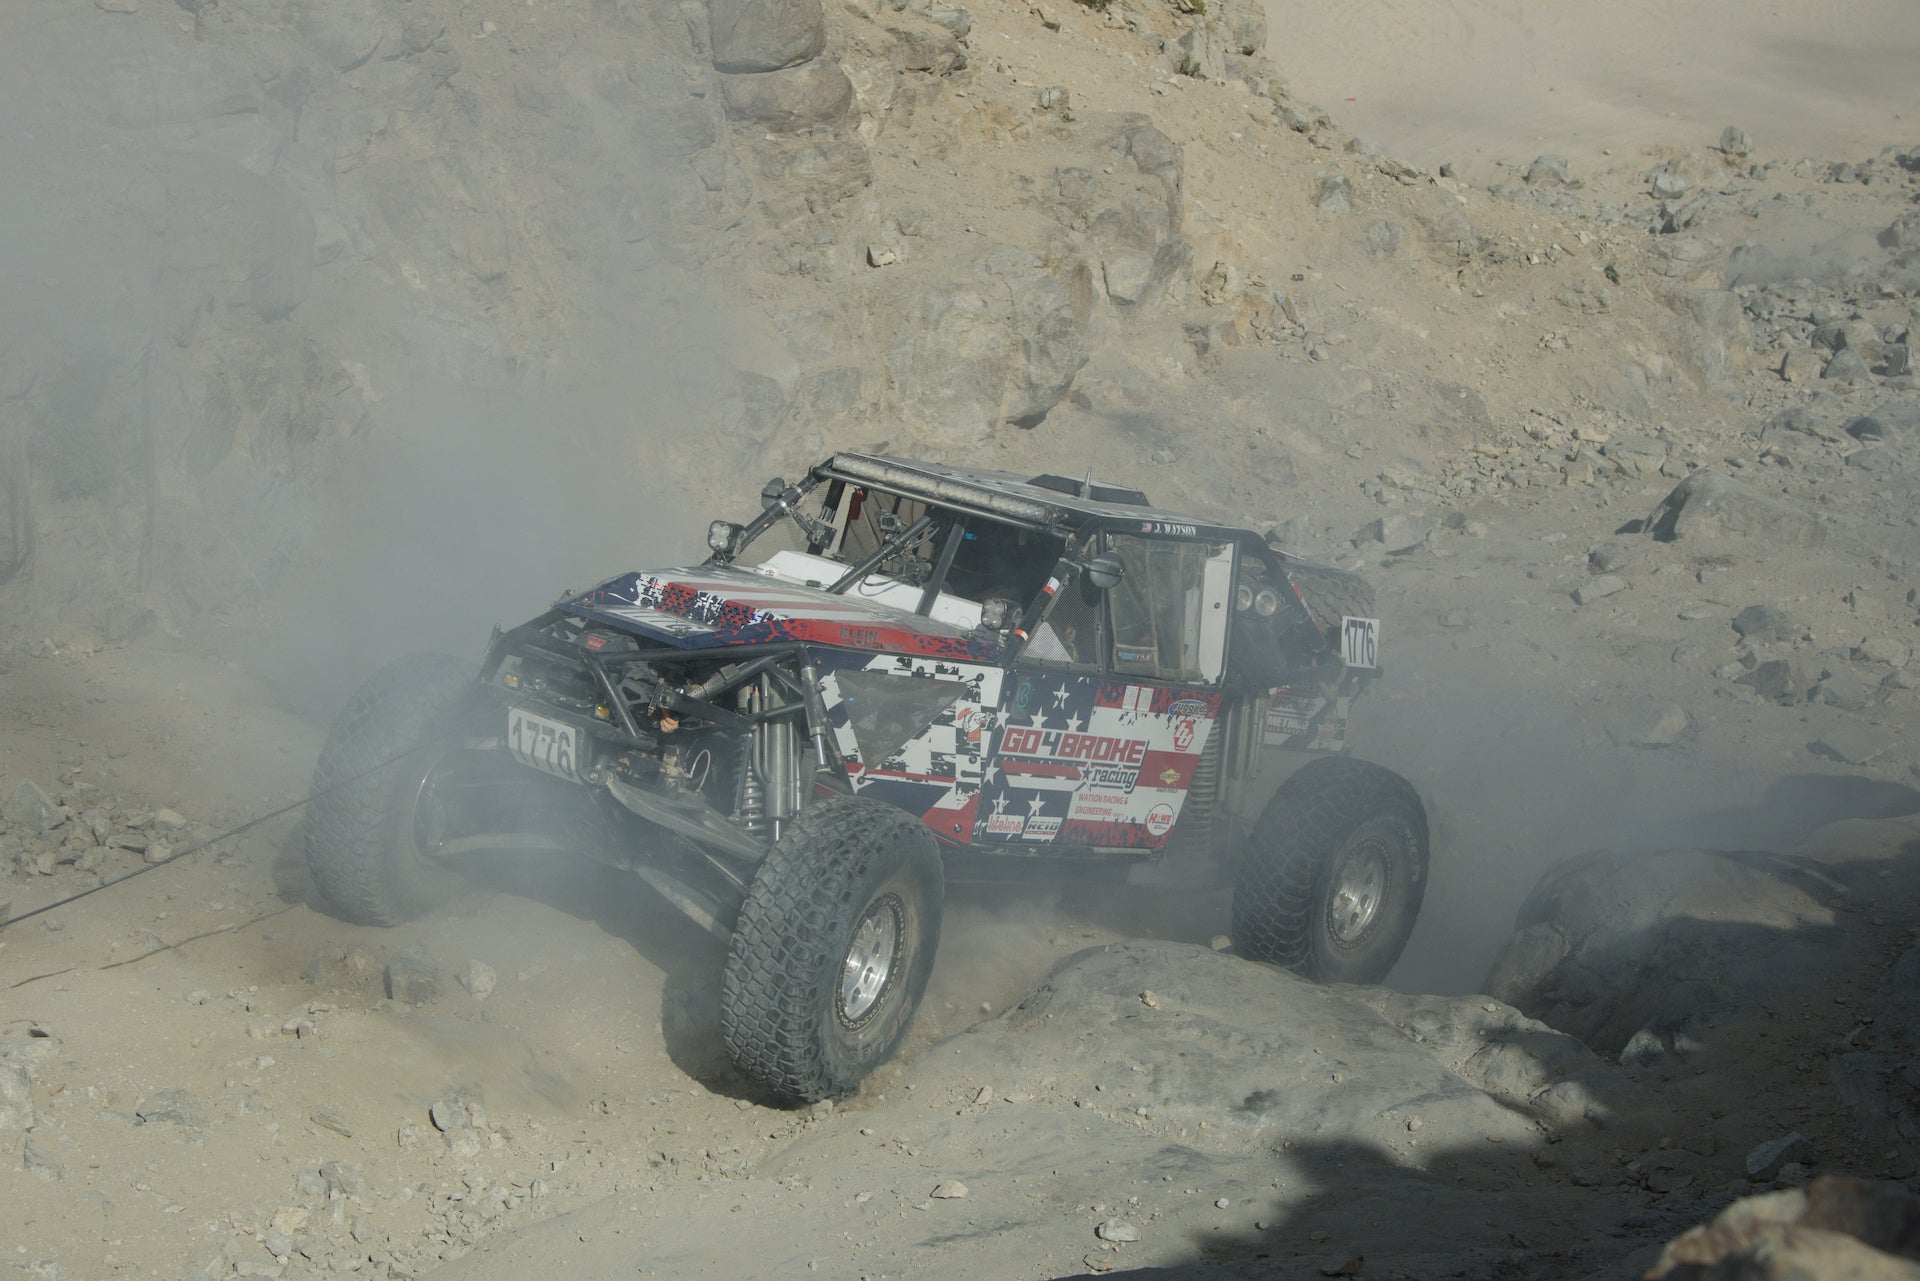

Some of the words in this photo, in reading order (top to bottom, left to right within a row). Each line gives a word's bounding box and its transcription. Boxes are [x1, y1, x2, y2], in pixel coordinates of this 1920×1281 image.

[1153, 523, 1162, 534] J.
[1163, 523, 1197, 537] WATSON
[839, 627, 879, 641] KLEIN
[1344, 618, 1375, 667] 1776
[512, 716, 575, 779] 1776
[1091, 766, 1138, 789] racing
[1078, 793, 1103, 803] WATSON
[1103, 795, 1124, 805] RACING
[1074, 805, 1113, 817] ENGINEERING
